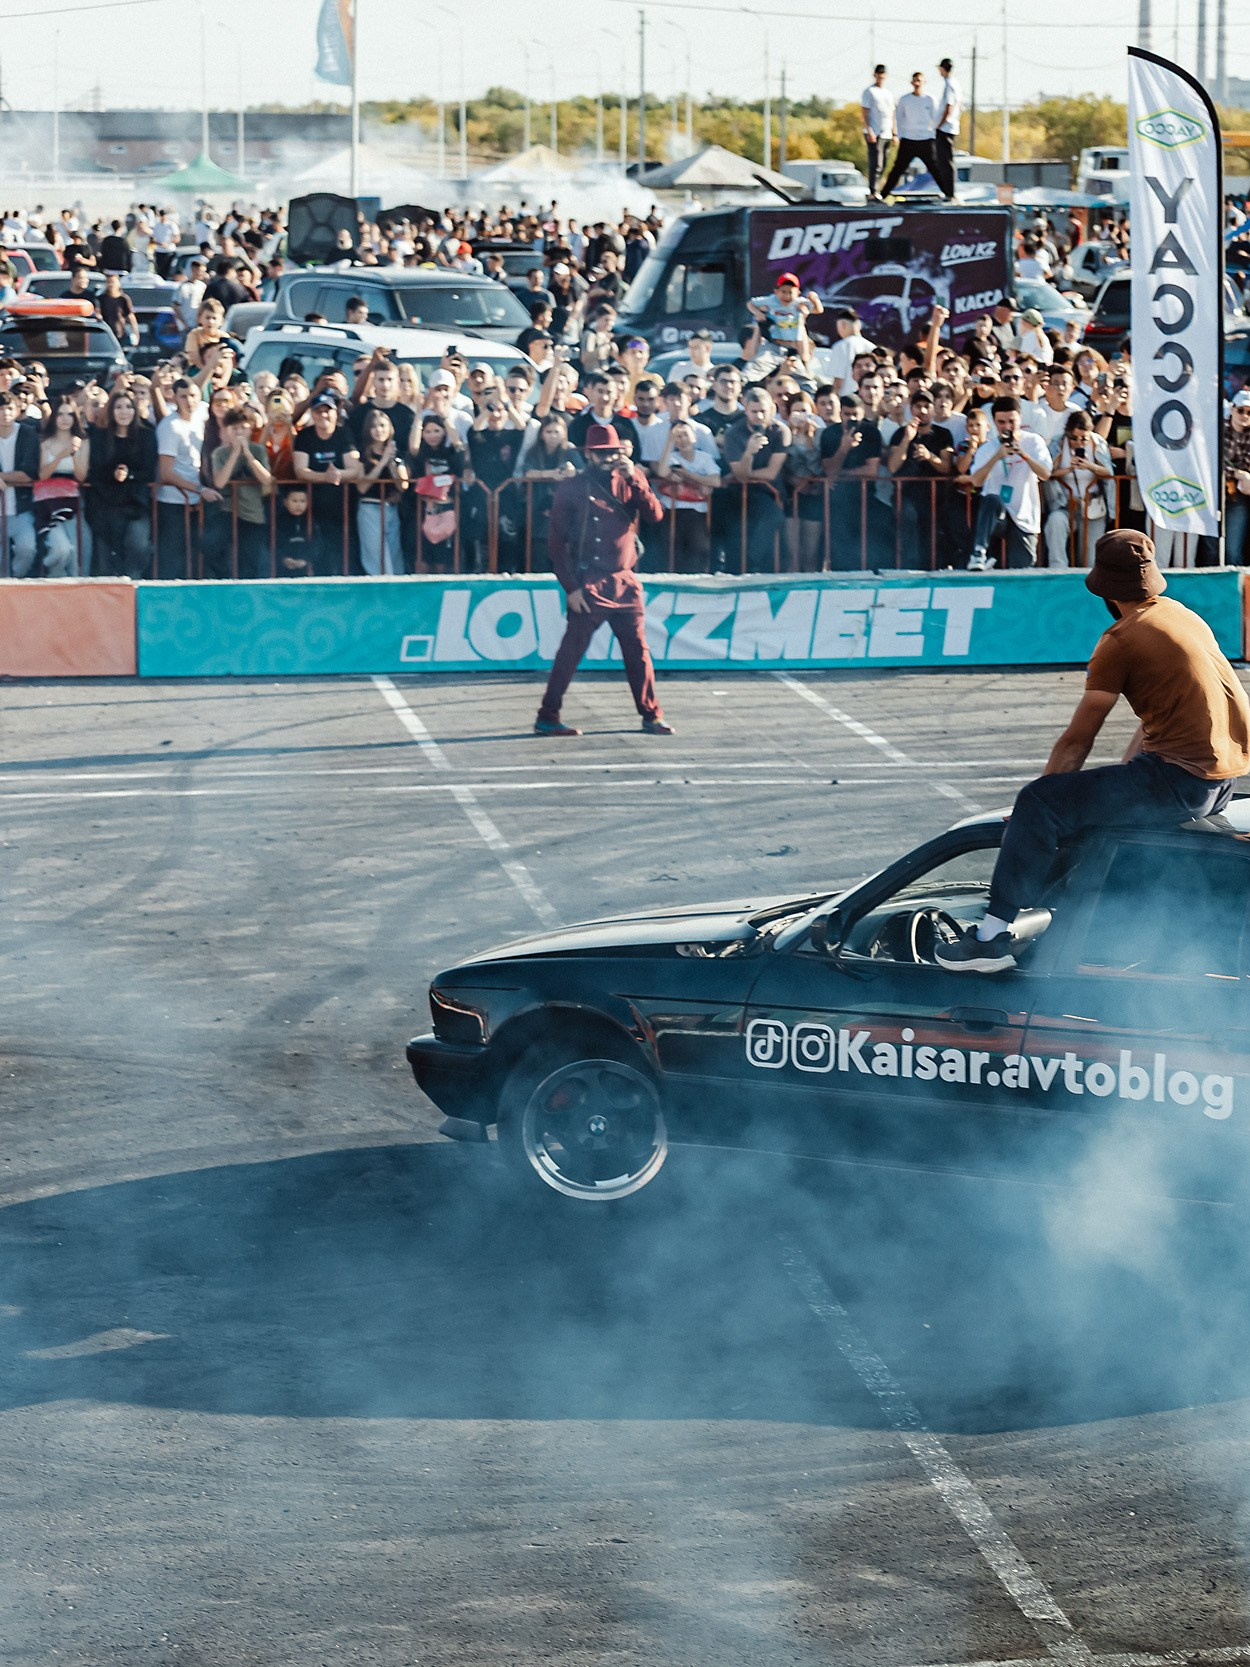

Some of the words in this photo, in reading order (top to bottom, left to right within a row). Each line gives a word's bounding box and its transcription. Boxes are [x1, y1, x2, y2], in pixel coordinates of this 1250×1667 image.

[767, 217, 903, 261] DRIFT
[940, 244, 976, 262] LOW
[837, 1027, 1235, 1121] Kaisar.avtoblog
